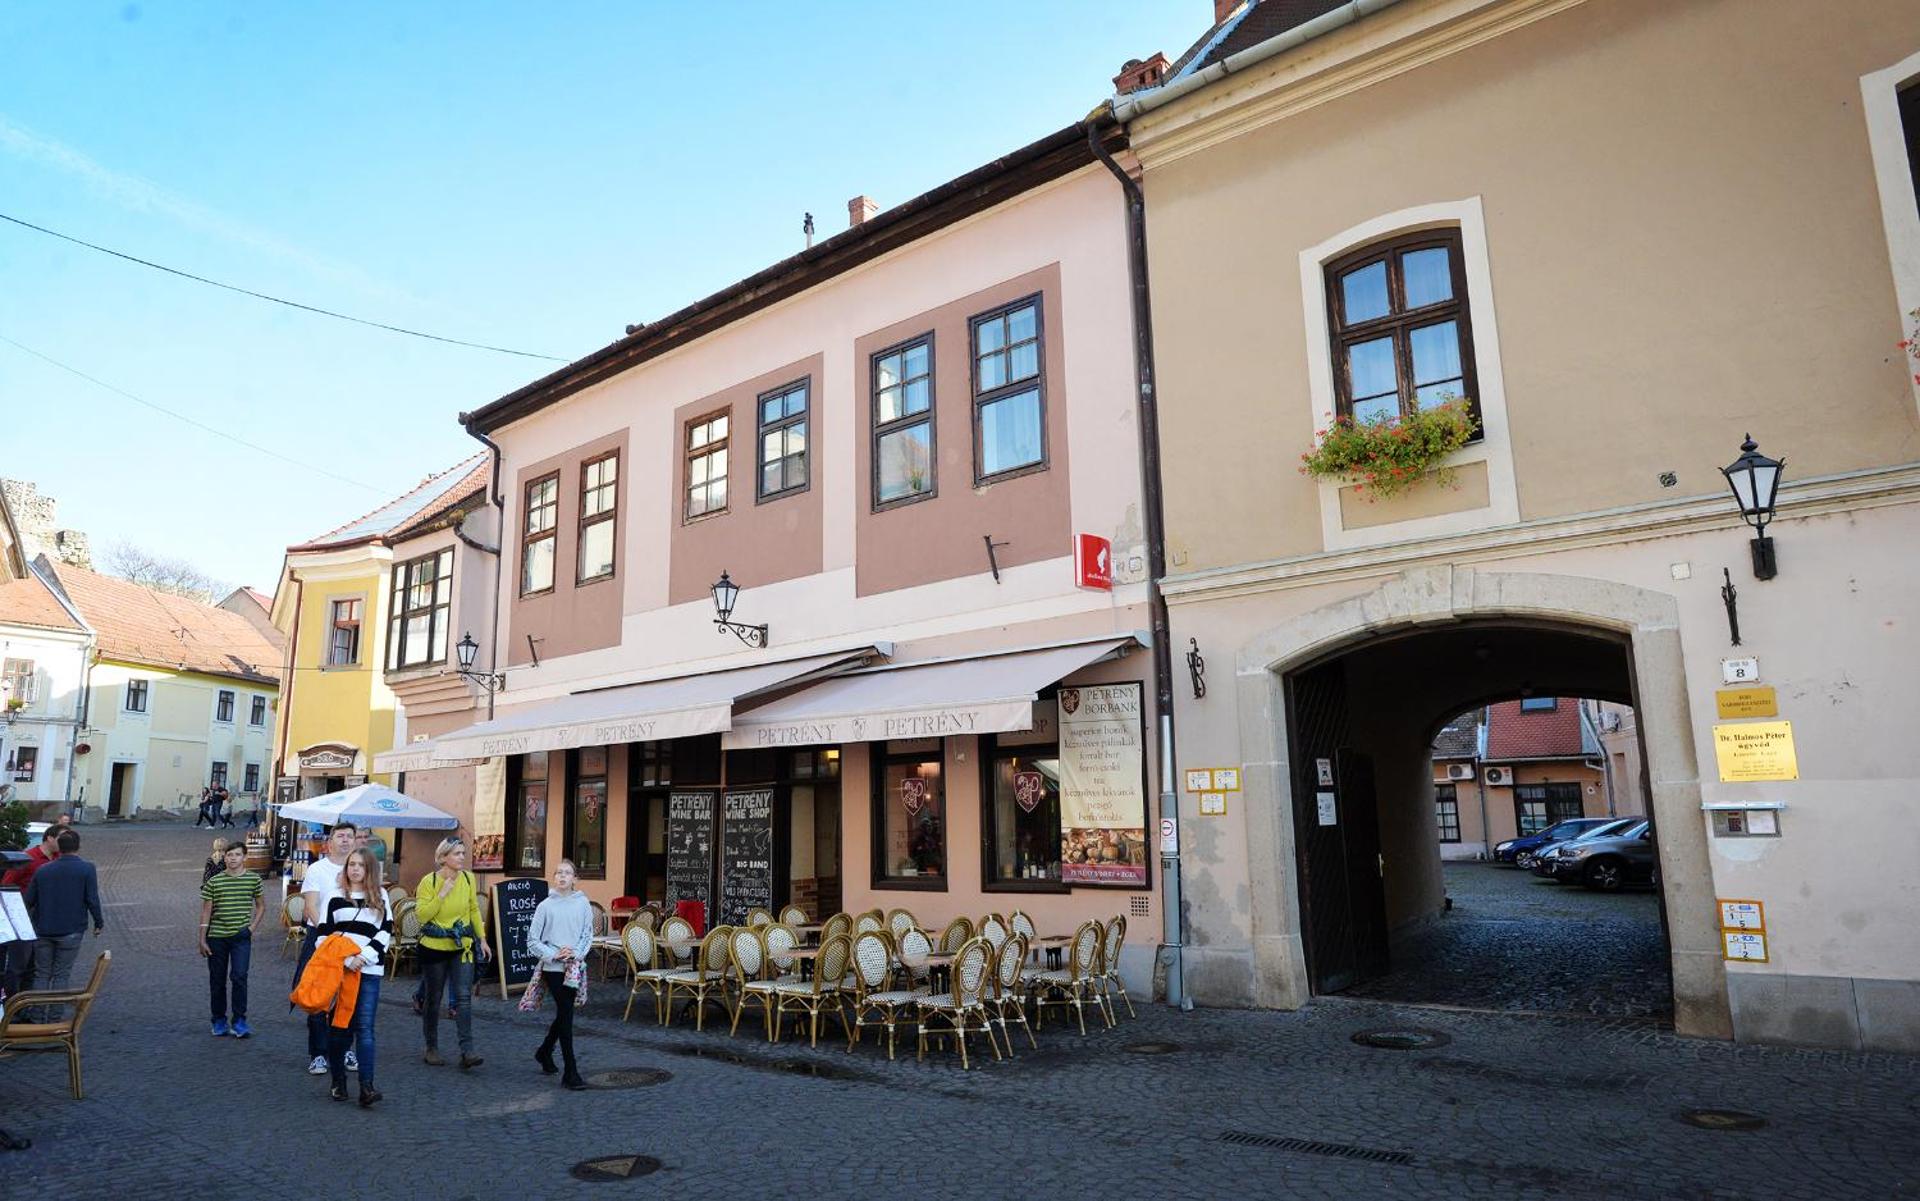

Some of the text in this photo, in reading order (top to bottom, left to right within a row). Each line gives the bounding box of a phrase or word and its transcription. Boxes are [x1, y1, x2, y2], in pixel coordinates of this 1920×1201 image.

[1736, 668, 1745, 678] 8
[1087, 686, 1135, 701] PETRÉNY
[1084, 702, 1138, 715] BORBANK
[595, 721, 656, 742] PETRÉNY
[884, 711, 979, 737] PETRÉNY
[757, 722, 837, 745] PETRÉNY
[671, 794, 712, 810] PETRÉNY
[725, 791, 771, 809] PETRÉNY
[671, 809, 711, 820] WINE BAR
[725, 807, 770, 820] WINE SHOP
[736, 860, 768, 869] BIG BAND
[507, 880, 531, 890] AKCIÓ
[510, 893, 537, 910] ROSÉ
